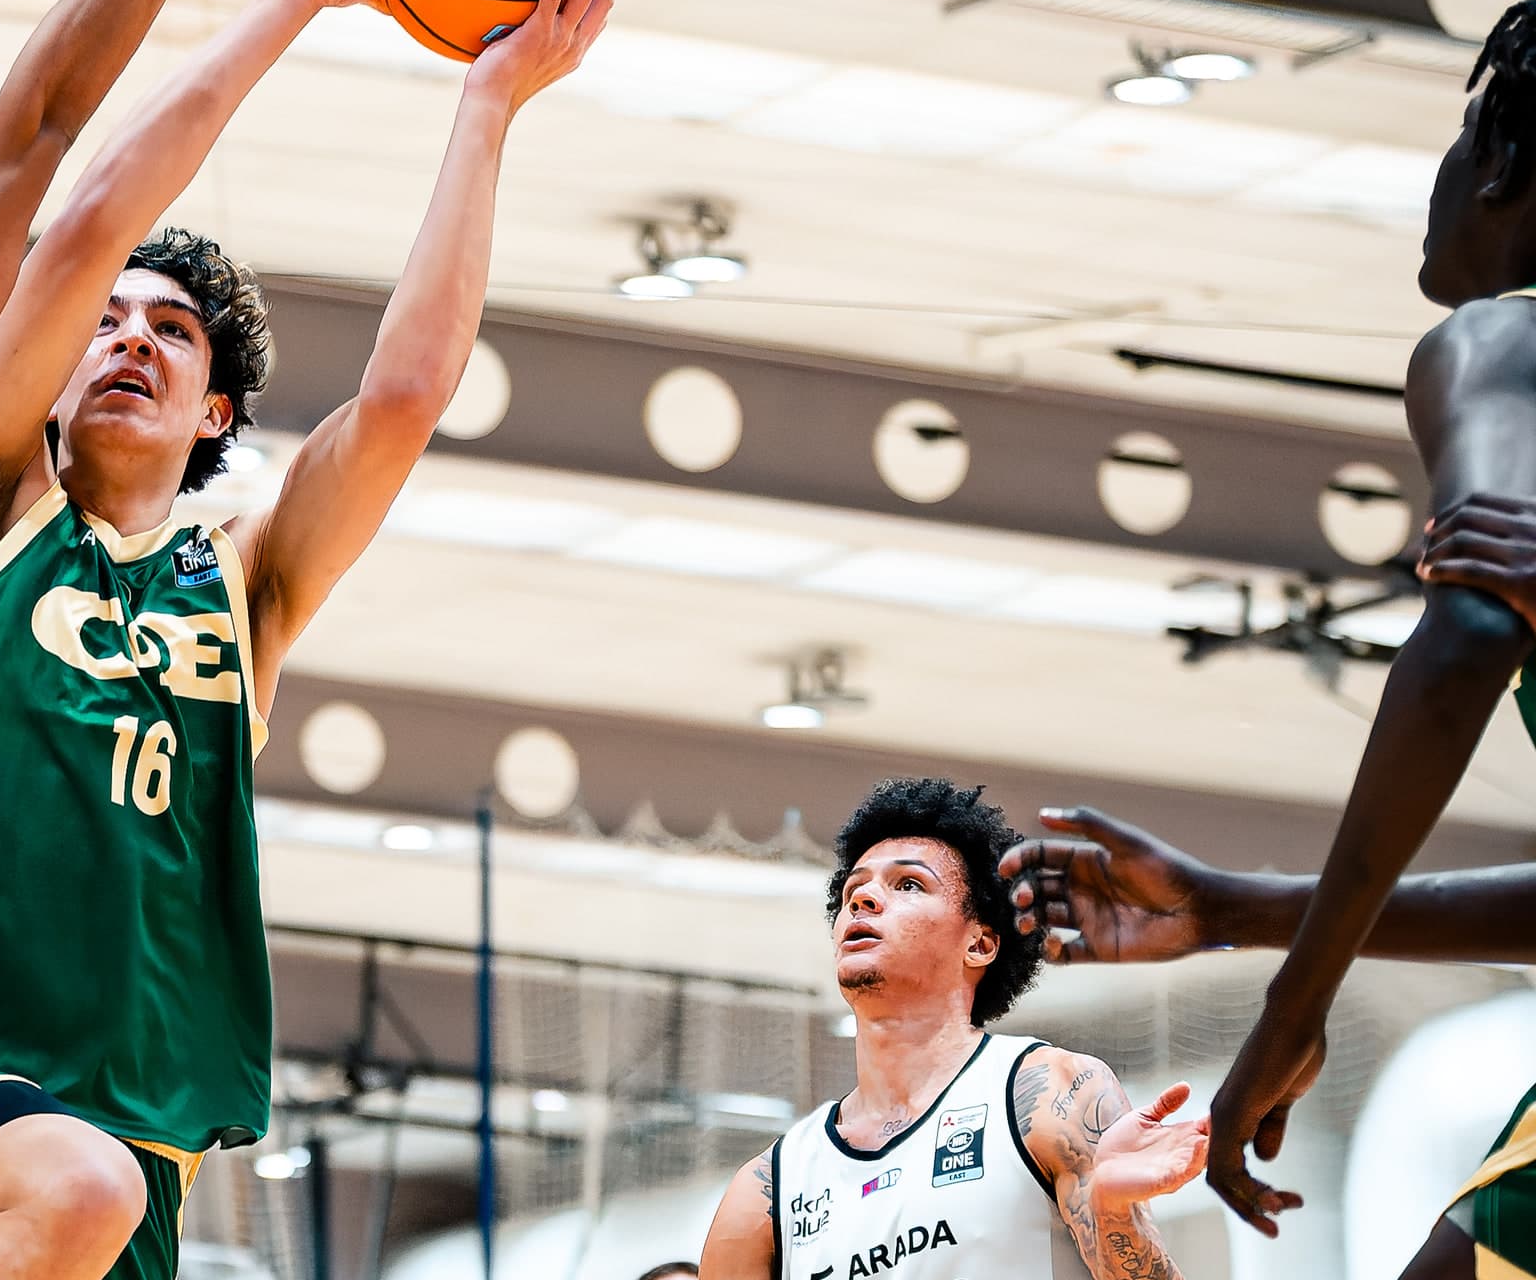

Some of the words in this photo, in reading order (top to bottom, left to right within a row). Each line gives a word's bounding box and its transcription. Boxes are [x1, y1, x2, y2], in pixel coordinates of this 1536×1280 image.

[111, 715, 177, 816] 16
[942, 1151, 974, 1172] ONE
[949, 1172, 966, 1181] EAST
